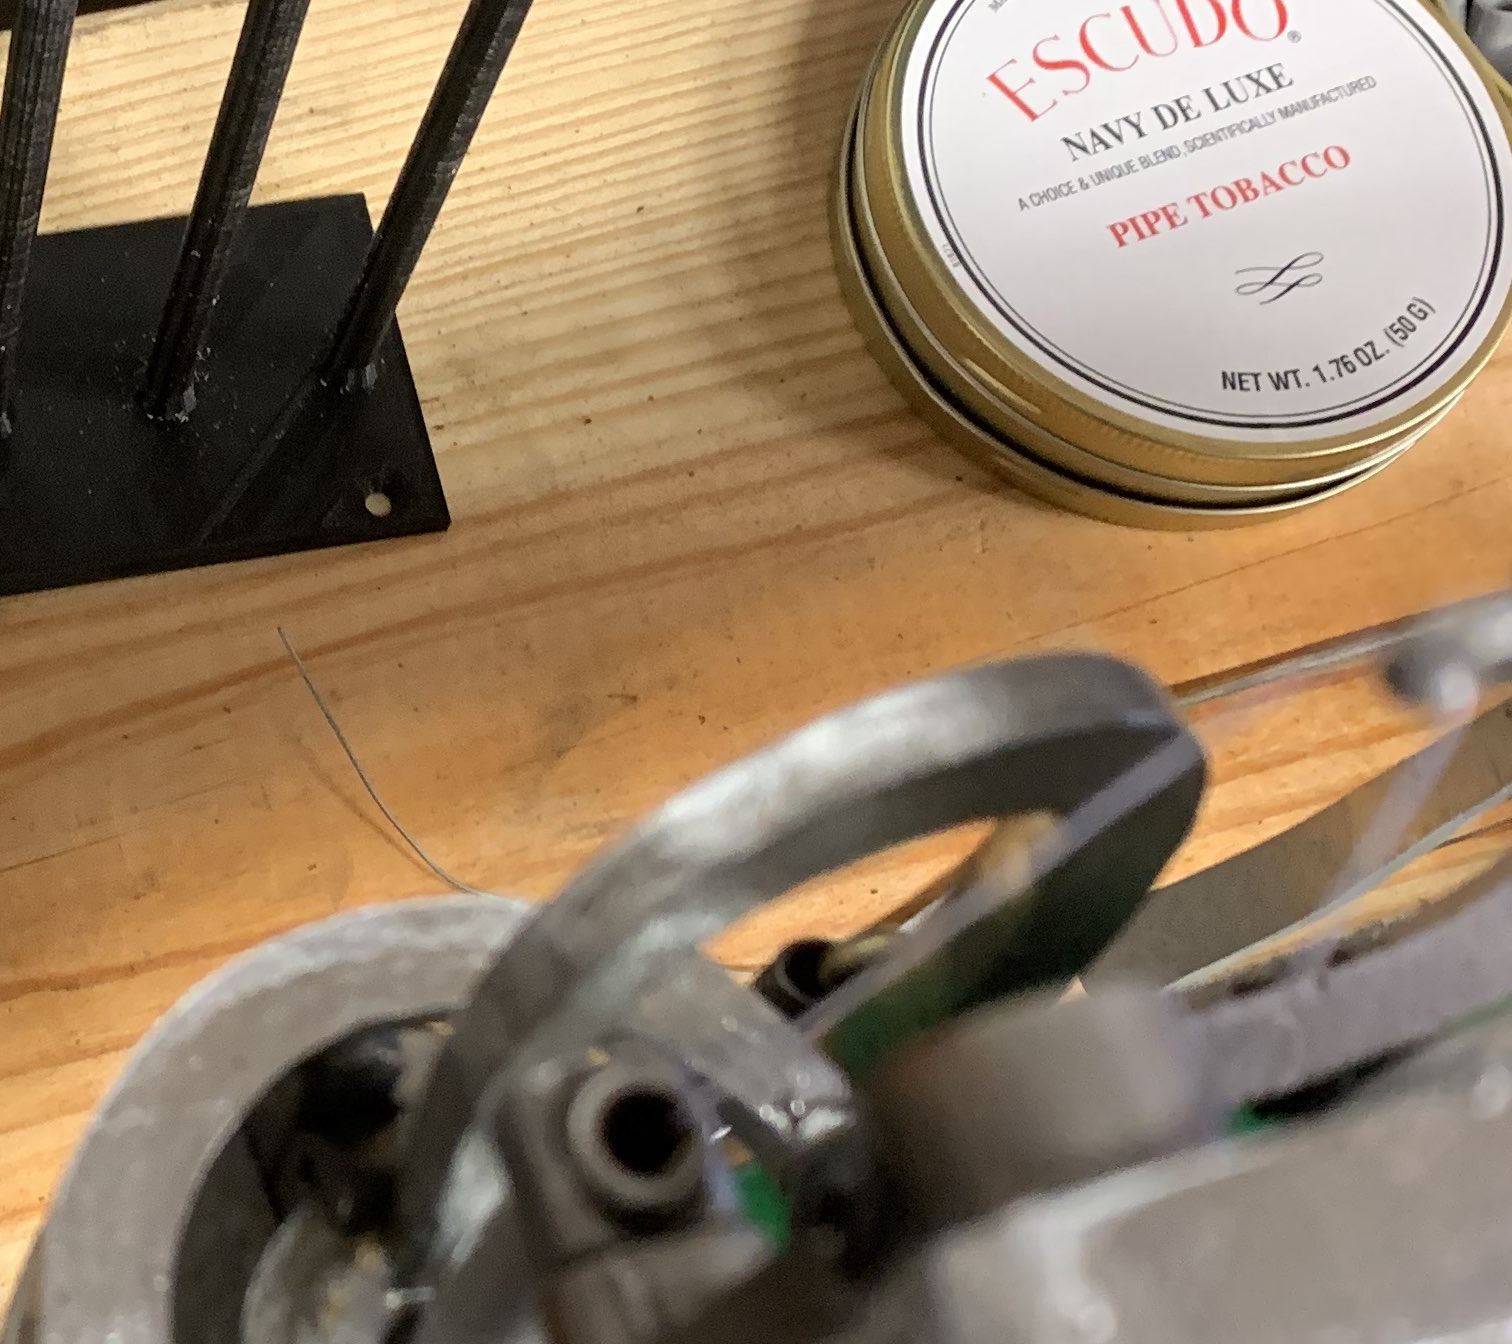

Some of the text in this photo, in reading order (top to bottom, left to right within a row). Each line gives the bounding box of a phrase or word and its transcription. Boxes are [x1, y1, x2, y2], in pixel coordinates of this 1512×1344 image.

[1017, 196, 1030, 211] A
[1029, 180, 1077, 208] CHOICE
[1077, 176, 1090, 191] &
[1091, 160, 1139, 188] UNIQUE
[1187, 110, 1278, 154] SCIENTIFICALLY
[1276, 74, 1378, 121] MANUFACTURED
[1060, 62, 1294, 162] NAVY DE LUXE
[1105, 144, 1352, 248] PIPE TOBACCO
[1221, 296, 1436, 392] NET WT. 1.76 OZ. (50 G)
